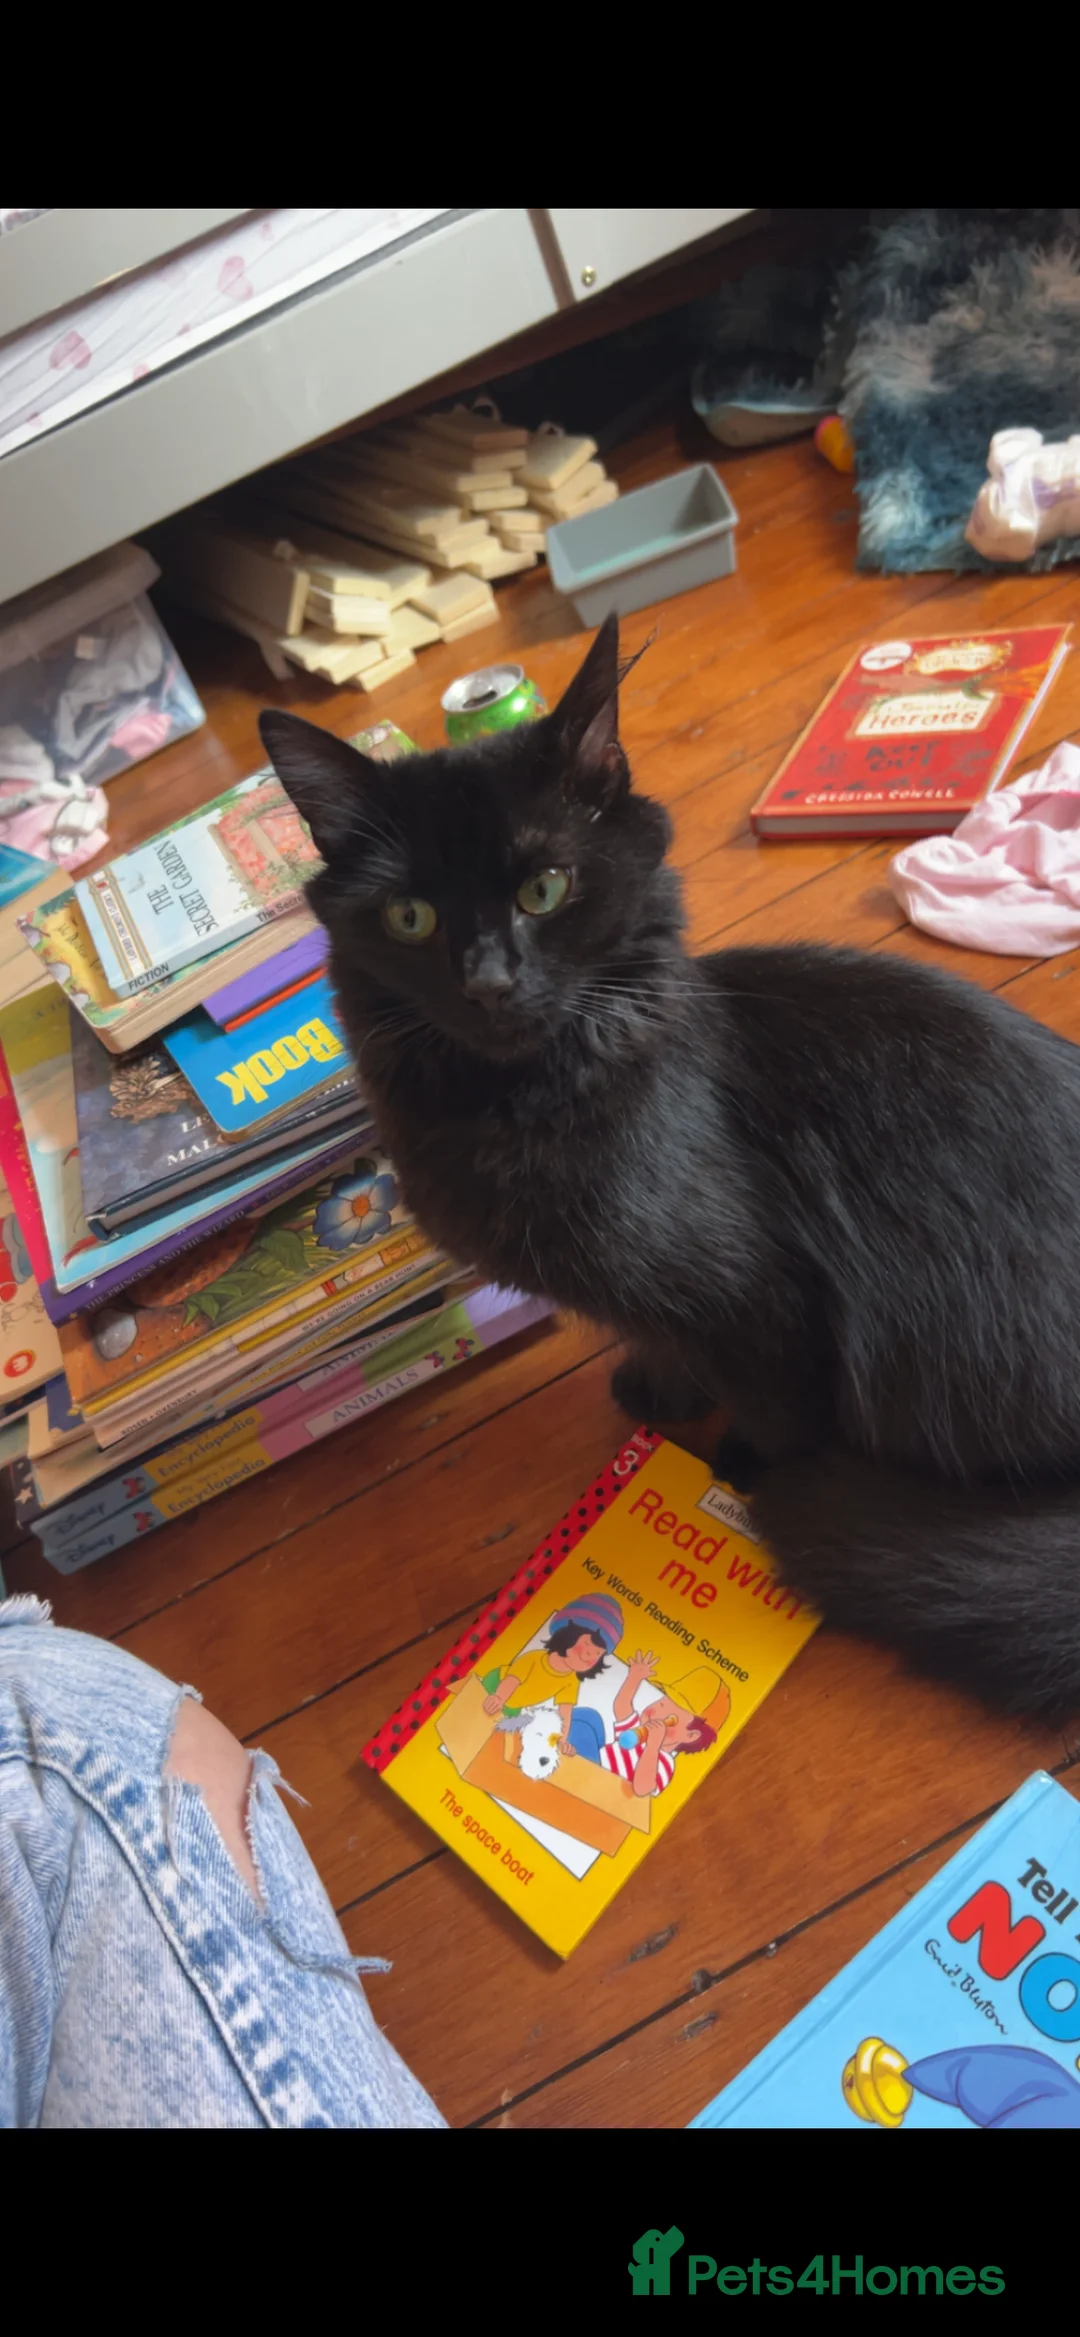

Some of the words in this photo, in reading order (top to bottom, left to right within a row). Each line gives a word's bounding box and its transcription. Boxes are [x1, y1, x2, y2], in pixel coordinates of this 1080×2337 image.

[154, 840, 193, 890] GARDEN
[146, 884, 175, 915] THE
[179, 888, 219, 937] SECRET
[256, 908, 276, 922] The
[128, 962, 170, 991] FICTION
[332, 1368, 419, 1423] ANIMALS
[158, 1415, 256, 1478] Encyclopedia
[614, 1450, 639, 1475] 3
[167, 1458, 266, 1514] Encyclopedia
[628, 1488, 728, 1565] Read
[657, 1559, 718, 1609] me
[581, 1556, 605, 1581] Key
[606, 1573, 644, 1607] Words
[644, 1602, 696, 1647] Reading
[696, 1639, 749, 1683] Scheme
[440, 1788, 464, 1817] The
[462, 1815, 502, 1855] space
[500, 1848, 535, 1887] boat
[1017, 1857, 1079, 1924] Tell
[947, 1880, 1080, 2044] NO
[960, 1972, 1008, 2036] Blyton
